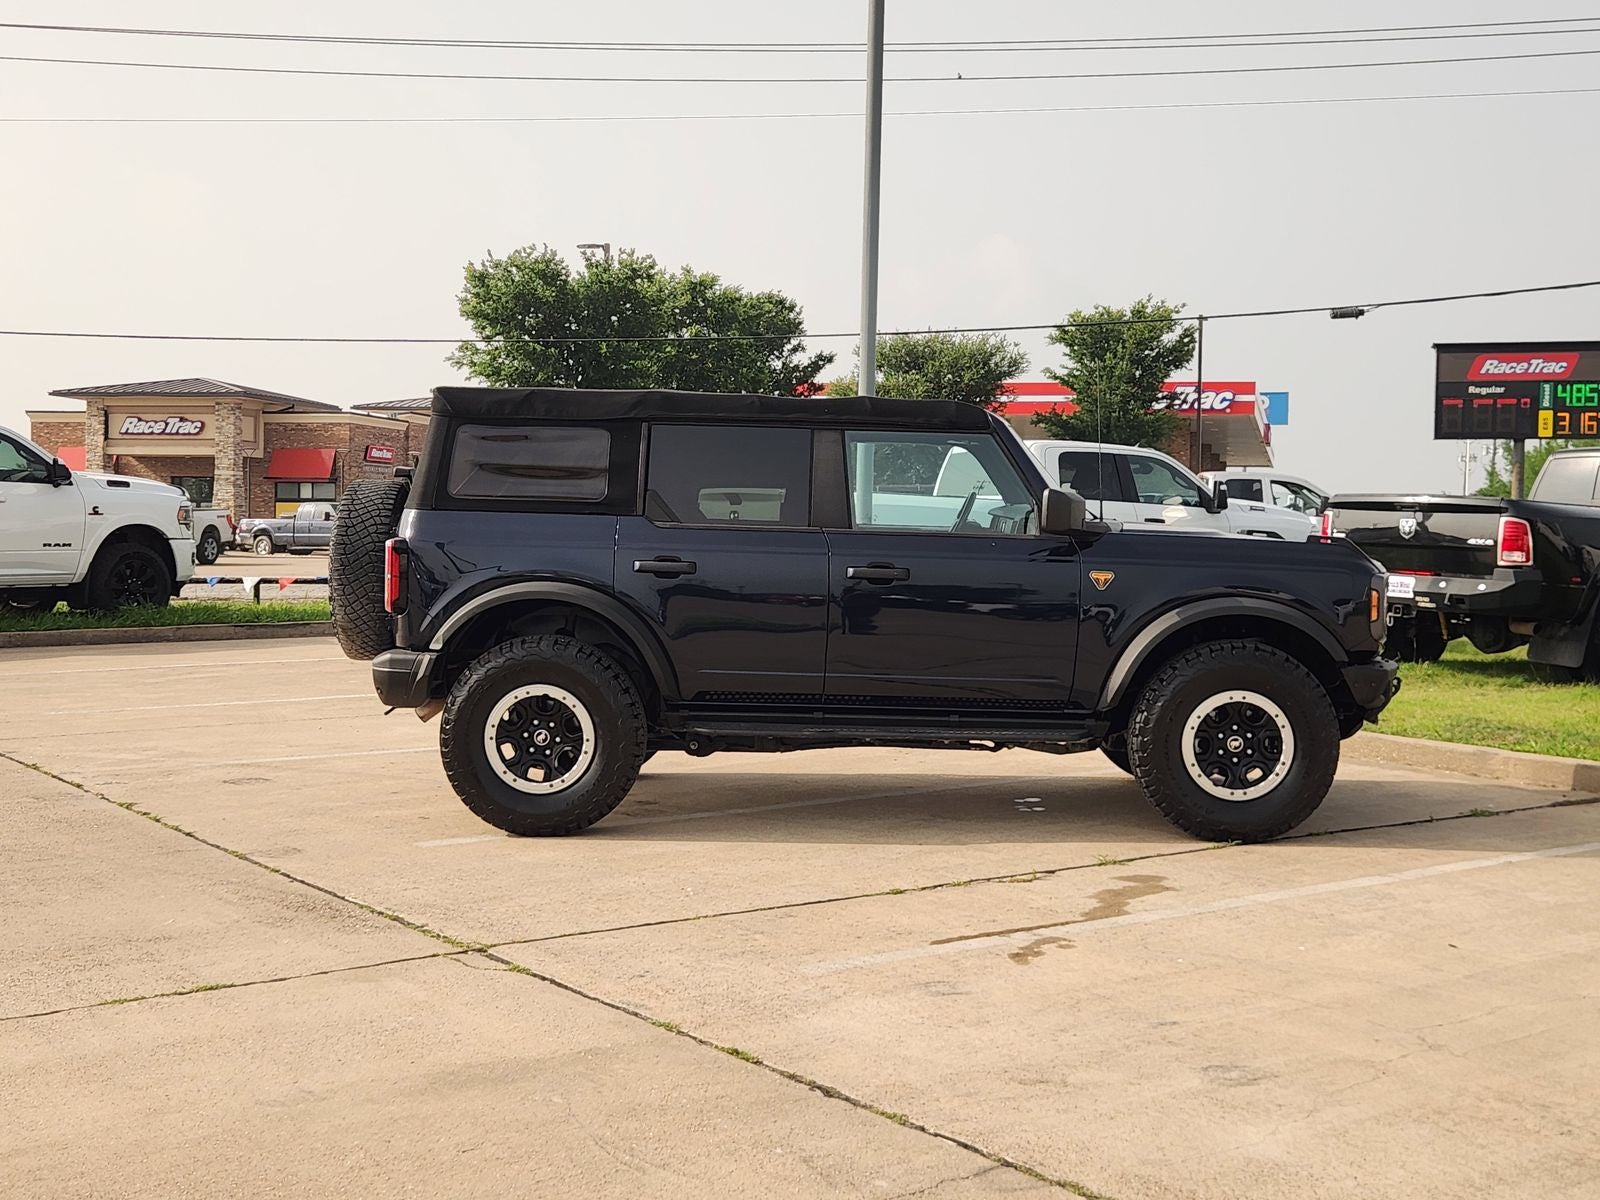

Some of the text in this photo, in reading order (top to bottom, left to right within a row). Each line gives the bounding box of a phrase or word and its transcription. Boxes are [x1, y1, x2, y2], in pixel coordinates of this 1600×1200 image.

[1480, 359, 1568, 374] RaceTrac
[1468, 385, 1506, 395] Regular
[119, 416, 203, 434] RaceTrac
